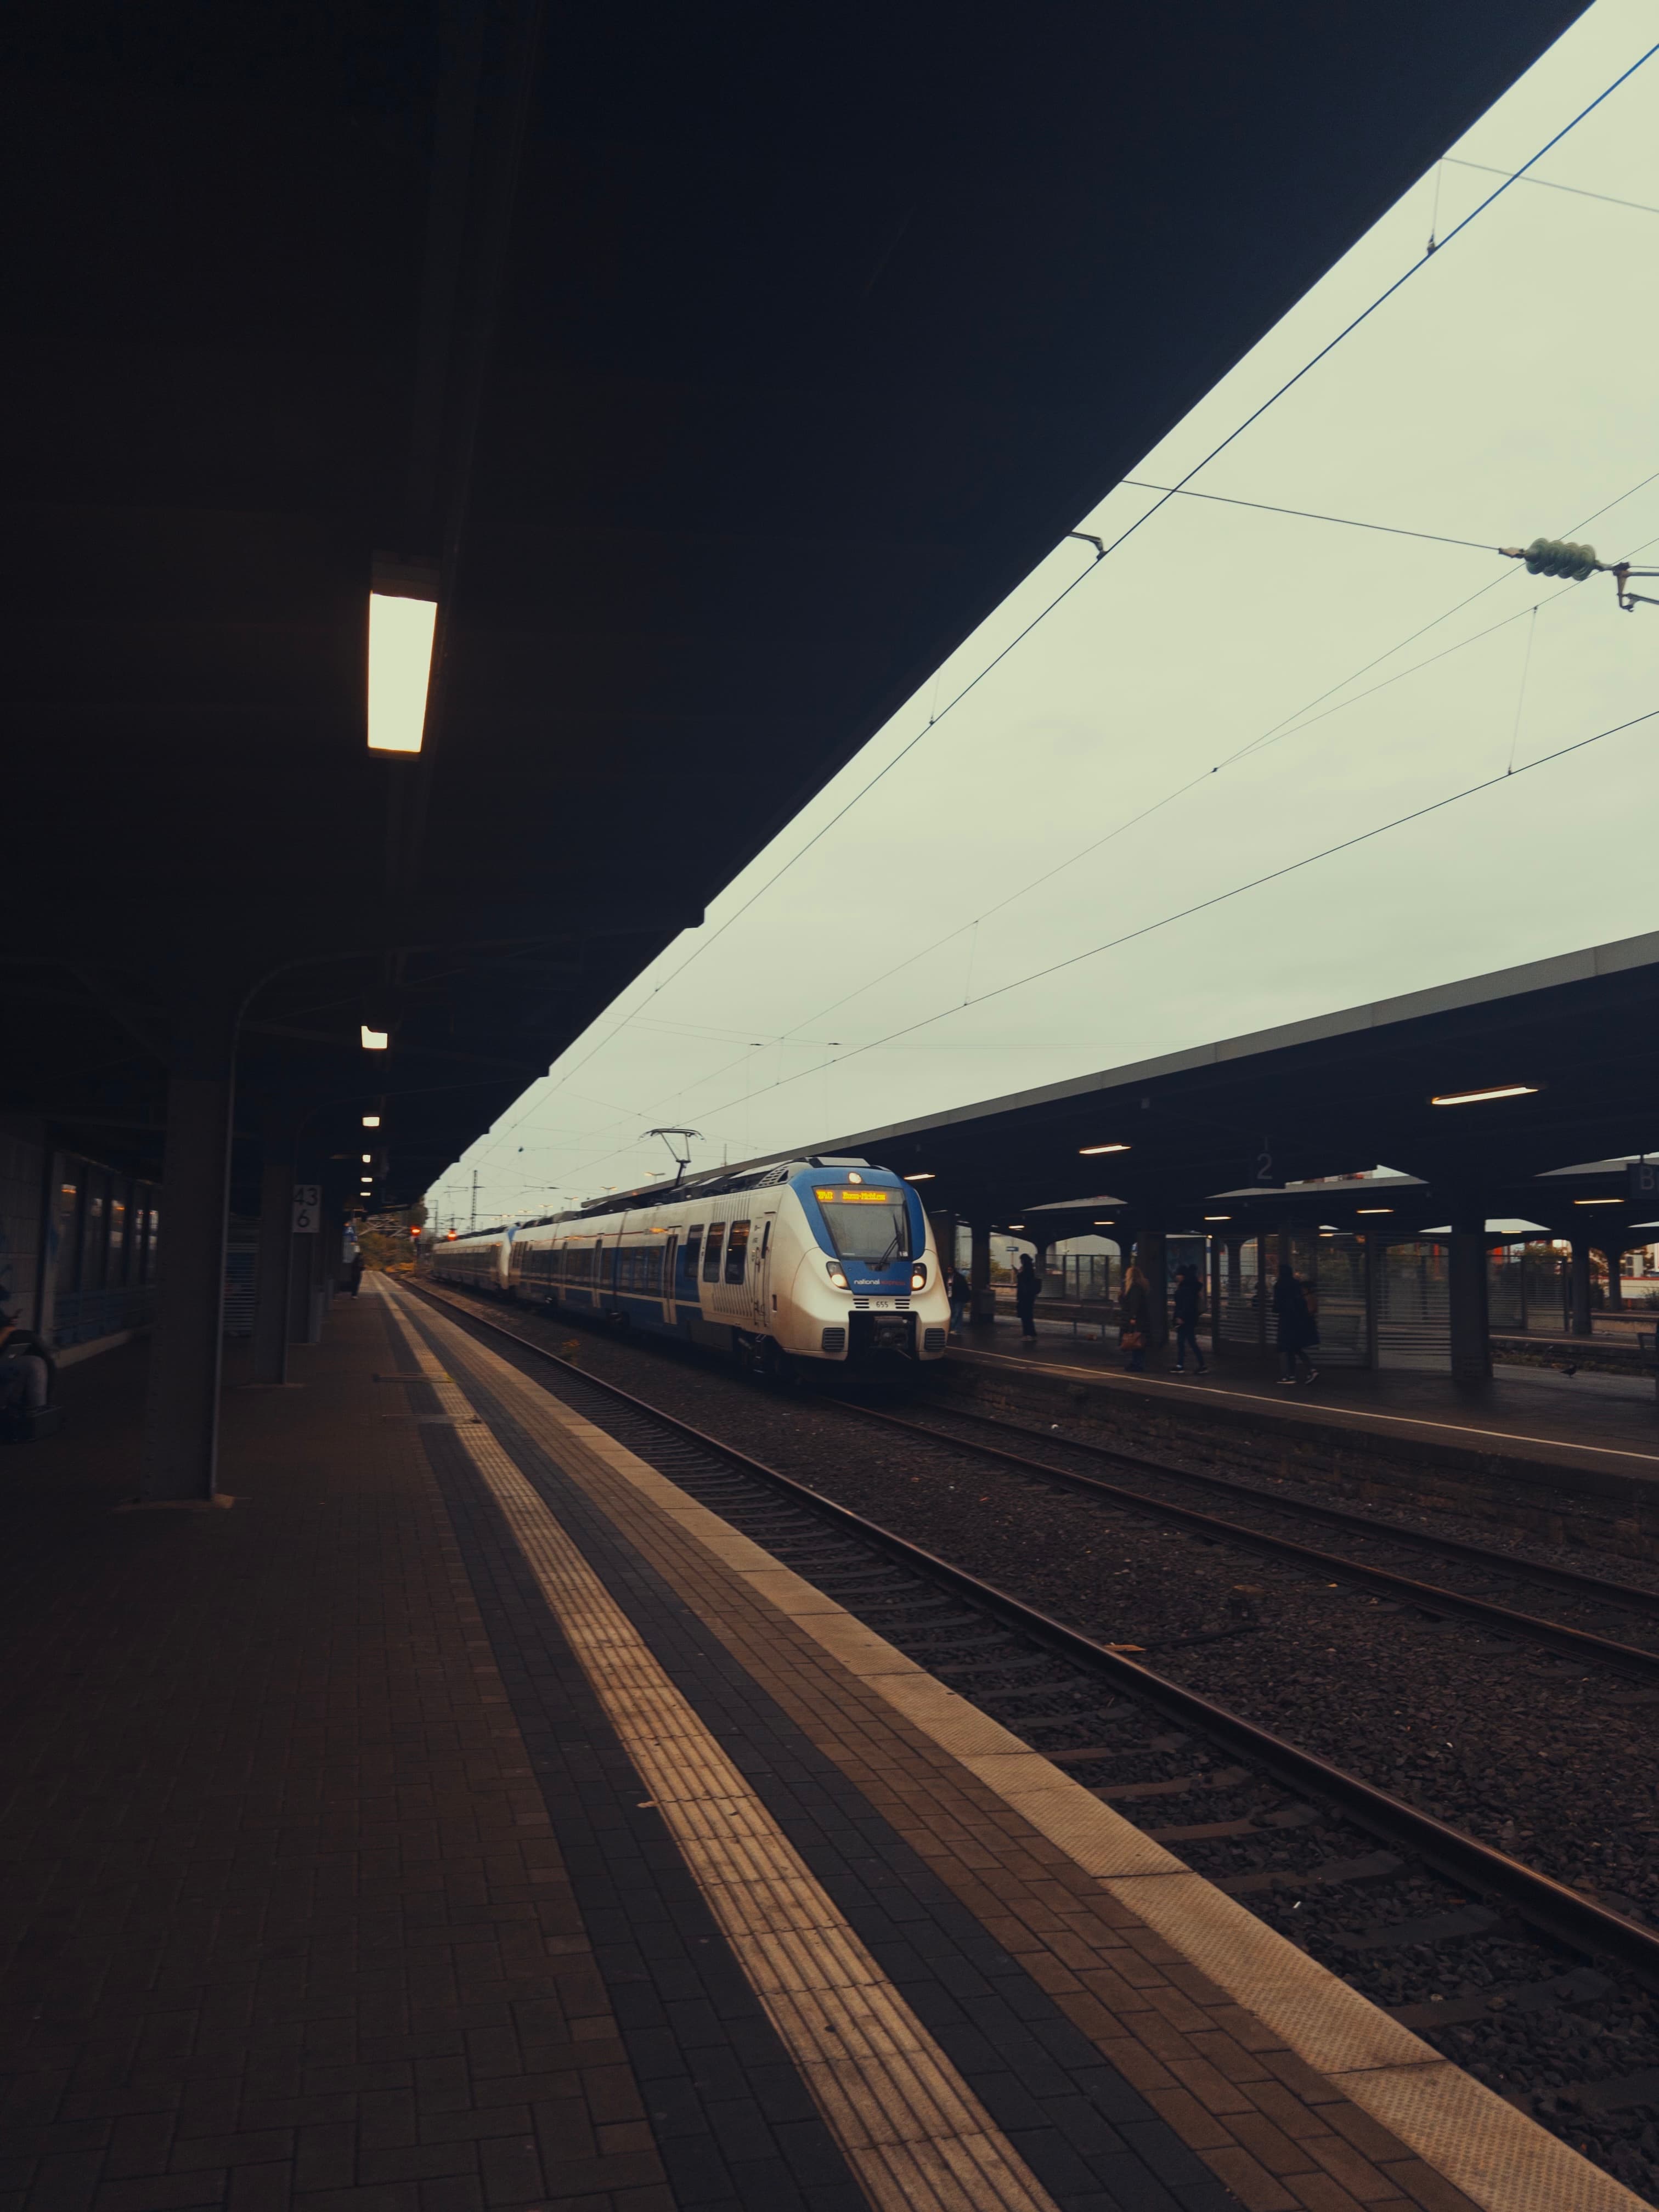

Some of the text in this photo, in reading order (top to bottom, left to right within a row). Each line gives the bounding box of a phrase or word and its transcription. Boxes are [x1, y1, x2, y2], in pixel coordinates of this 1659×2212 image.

[1256, 1153, 1273, 1180] 2
[294, 1187, 318, 1206] 43
[297, 1209, 311, 1227] 6
